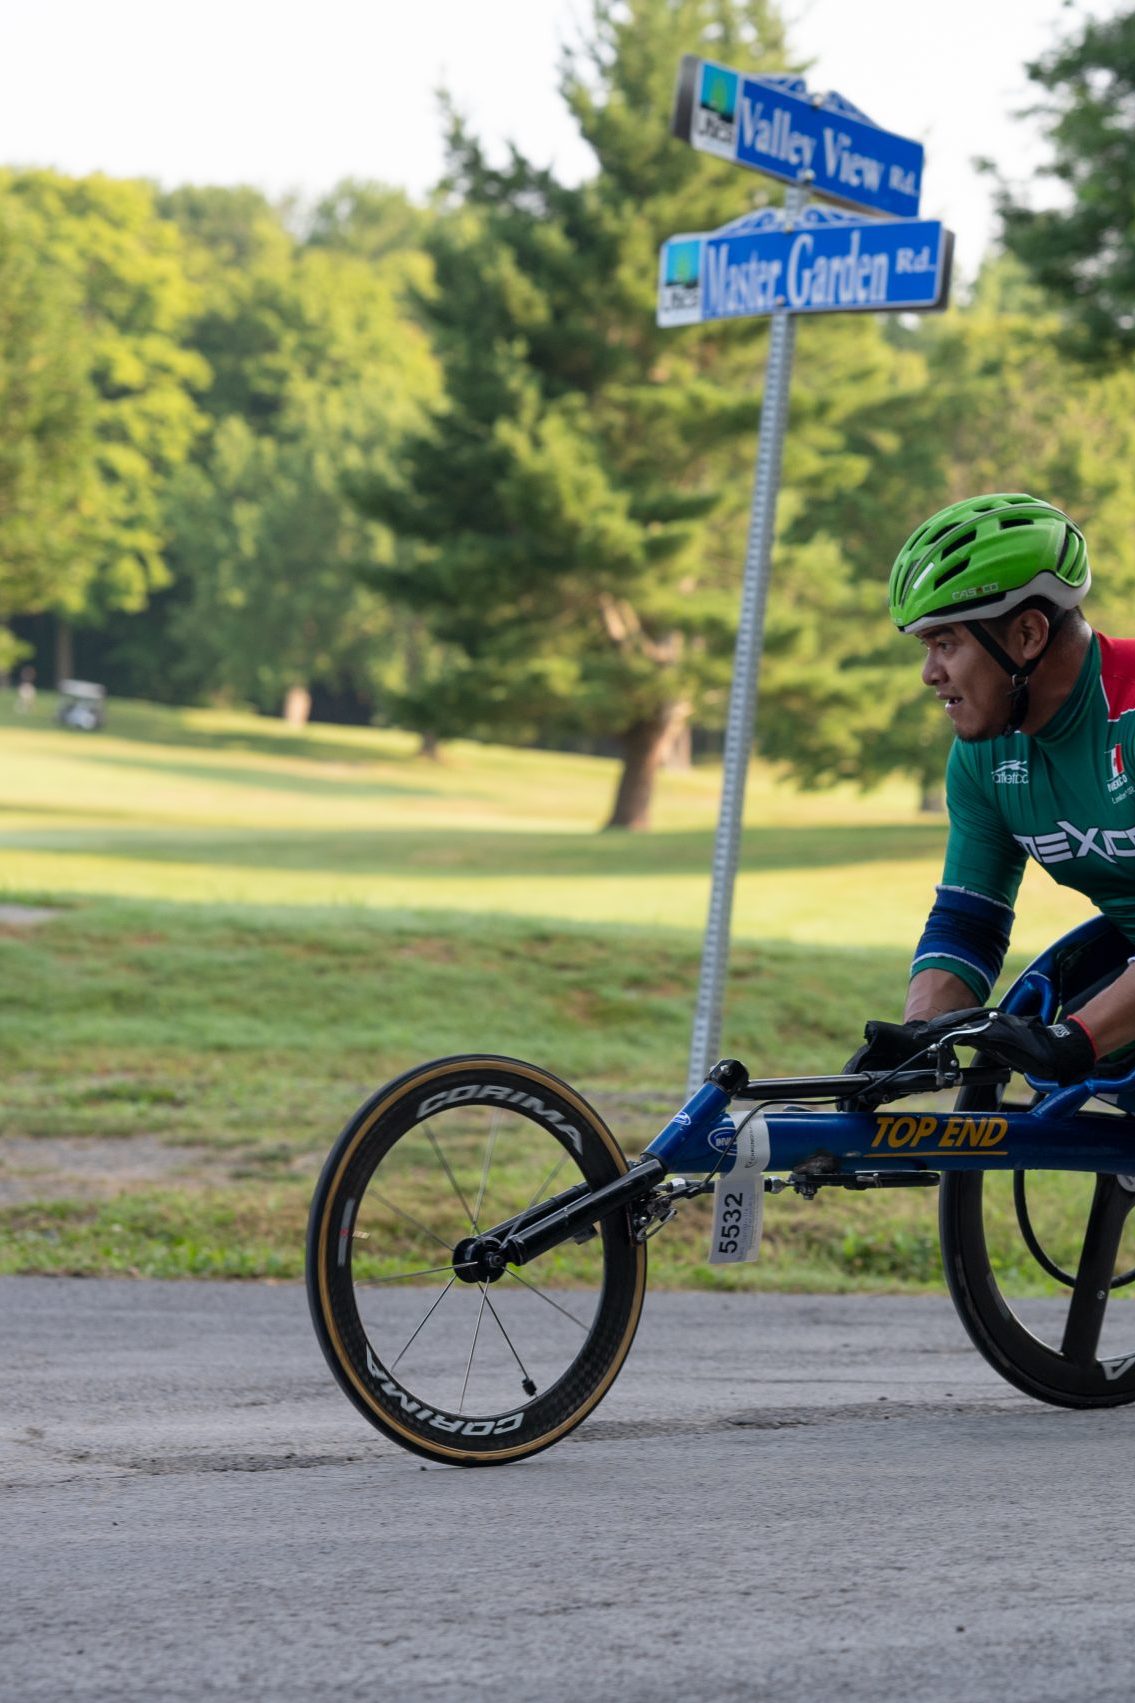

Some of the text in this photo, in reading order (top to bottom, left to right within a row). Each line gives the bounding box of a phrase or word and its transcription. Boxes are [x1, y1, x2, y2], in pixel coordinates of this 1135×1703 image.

[741, 96, 816, 169] Valley
[823, 126, 885, 192] View
[706, 242, 782, 313] Master
[787, 230, 889, 307] Garden
[416, 1084, 584, 1156] CORIMA
[870, 1116, 1009, 1148] TOP END
[718, 1192, 743, 1254] 5532
[365, 1342, 525, 1436] CORIMA
